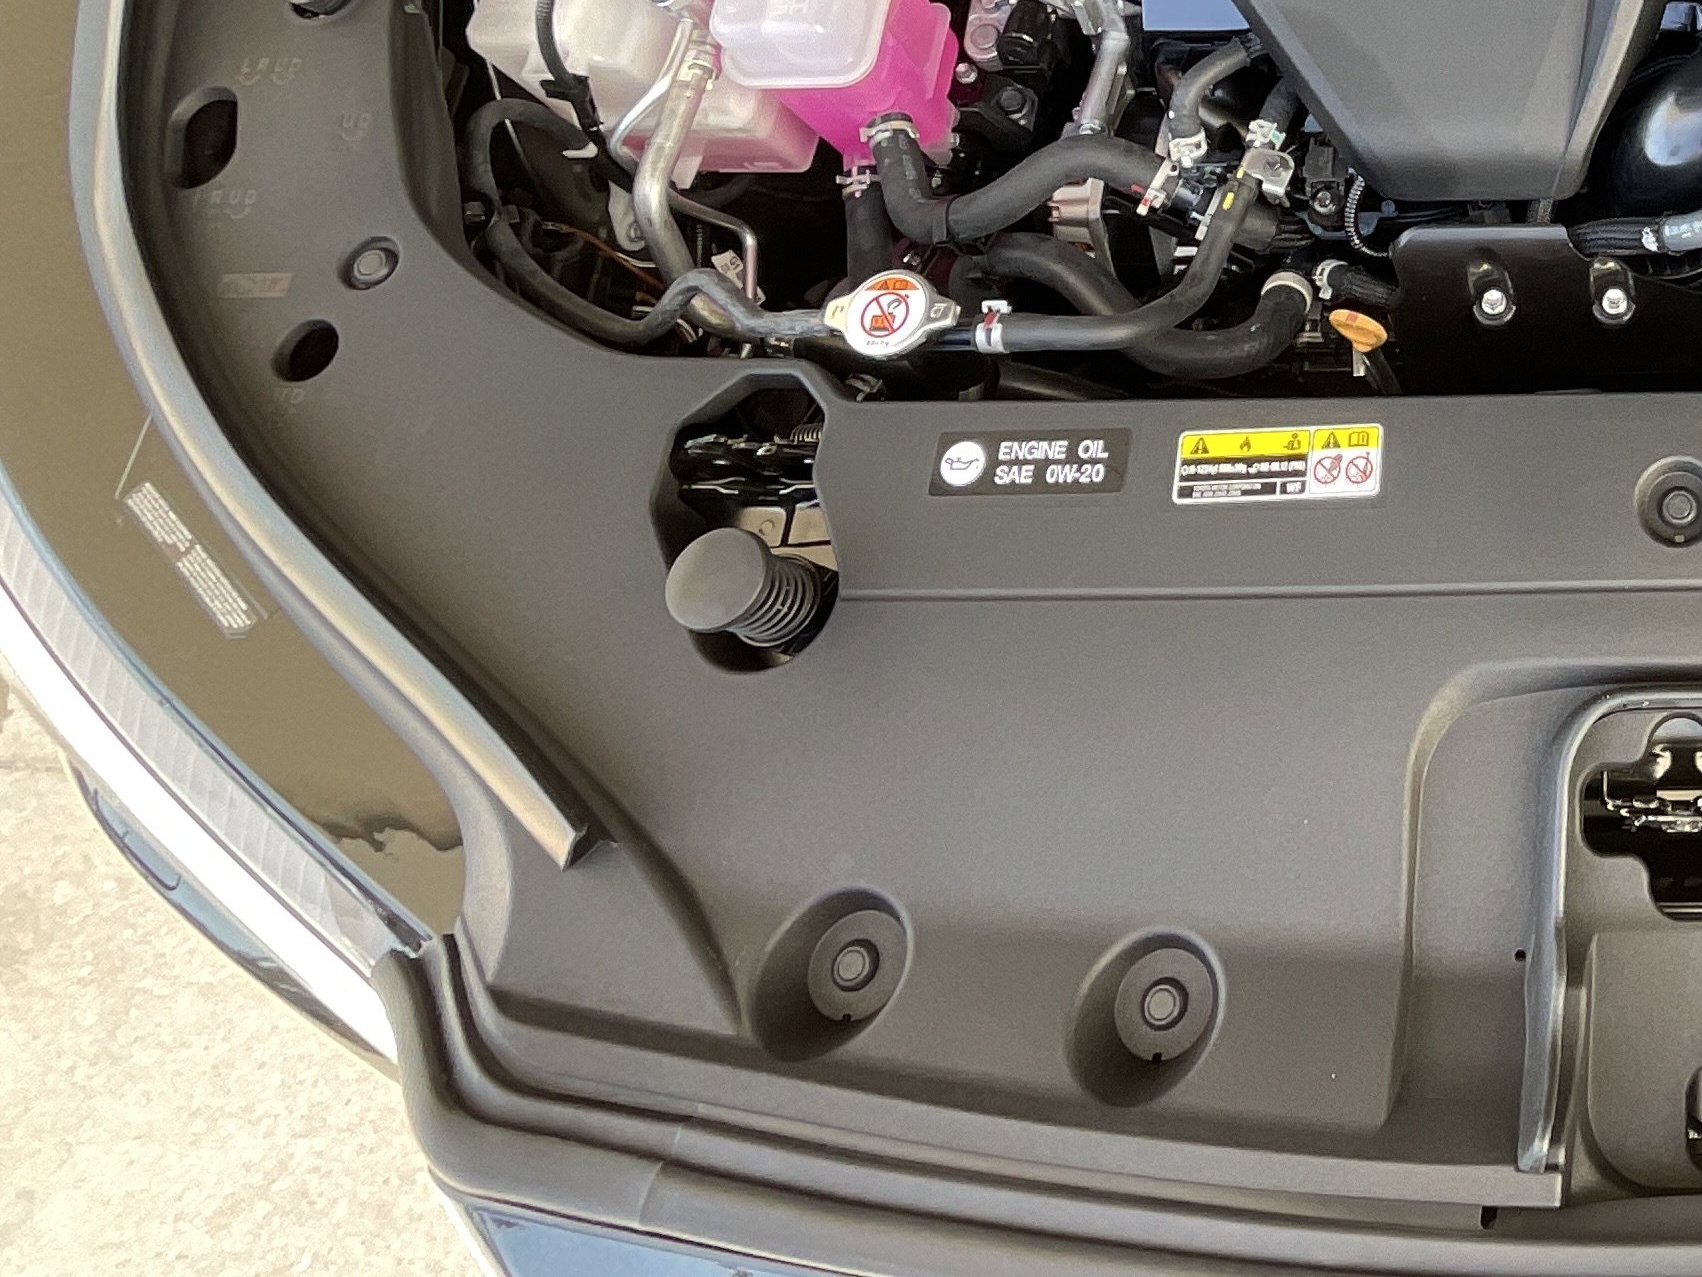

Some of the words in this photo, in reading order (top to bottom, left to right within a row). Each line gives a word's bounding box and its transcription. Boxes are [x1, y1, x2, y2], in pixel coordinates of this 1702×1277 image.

[998, 440, 1069, 460] ENGINE
[1077, 439, 1109, 459] OIL
[993, 464, 1035, 485] SAE
[1045, 463, 1105, 484] 0W-20
